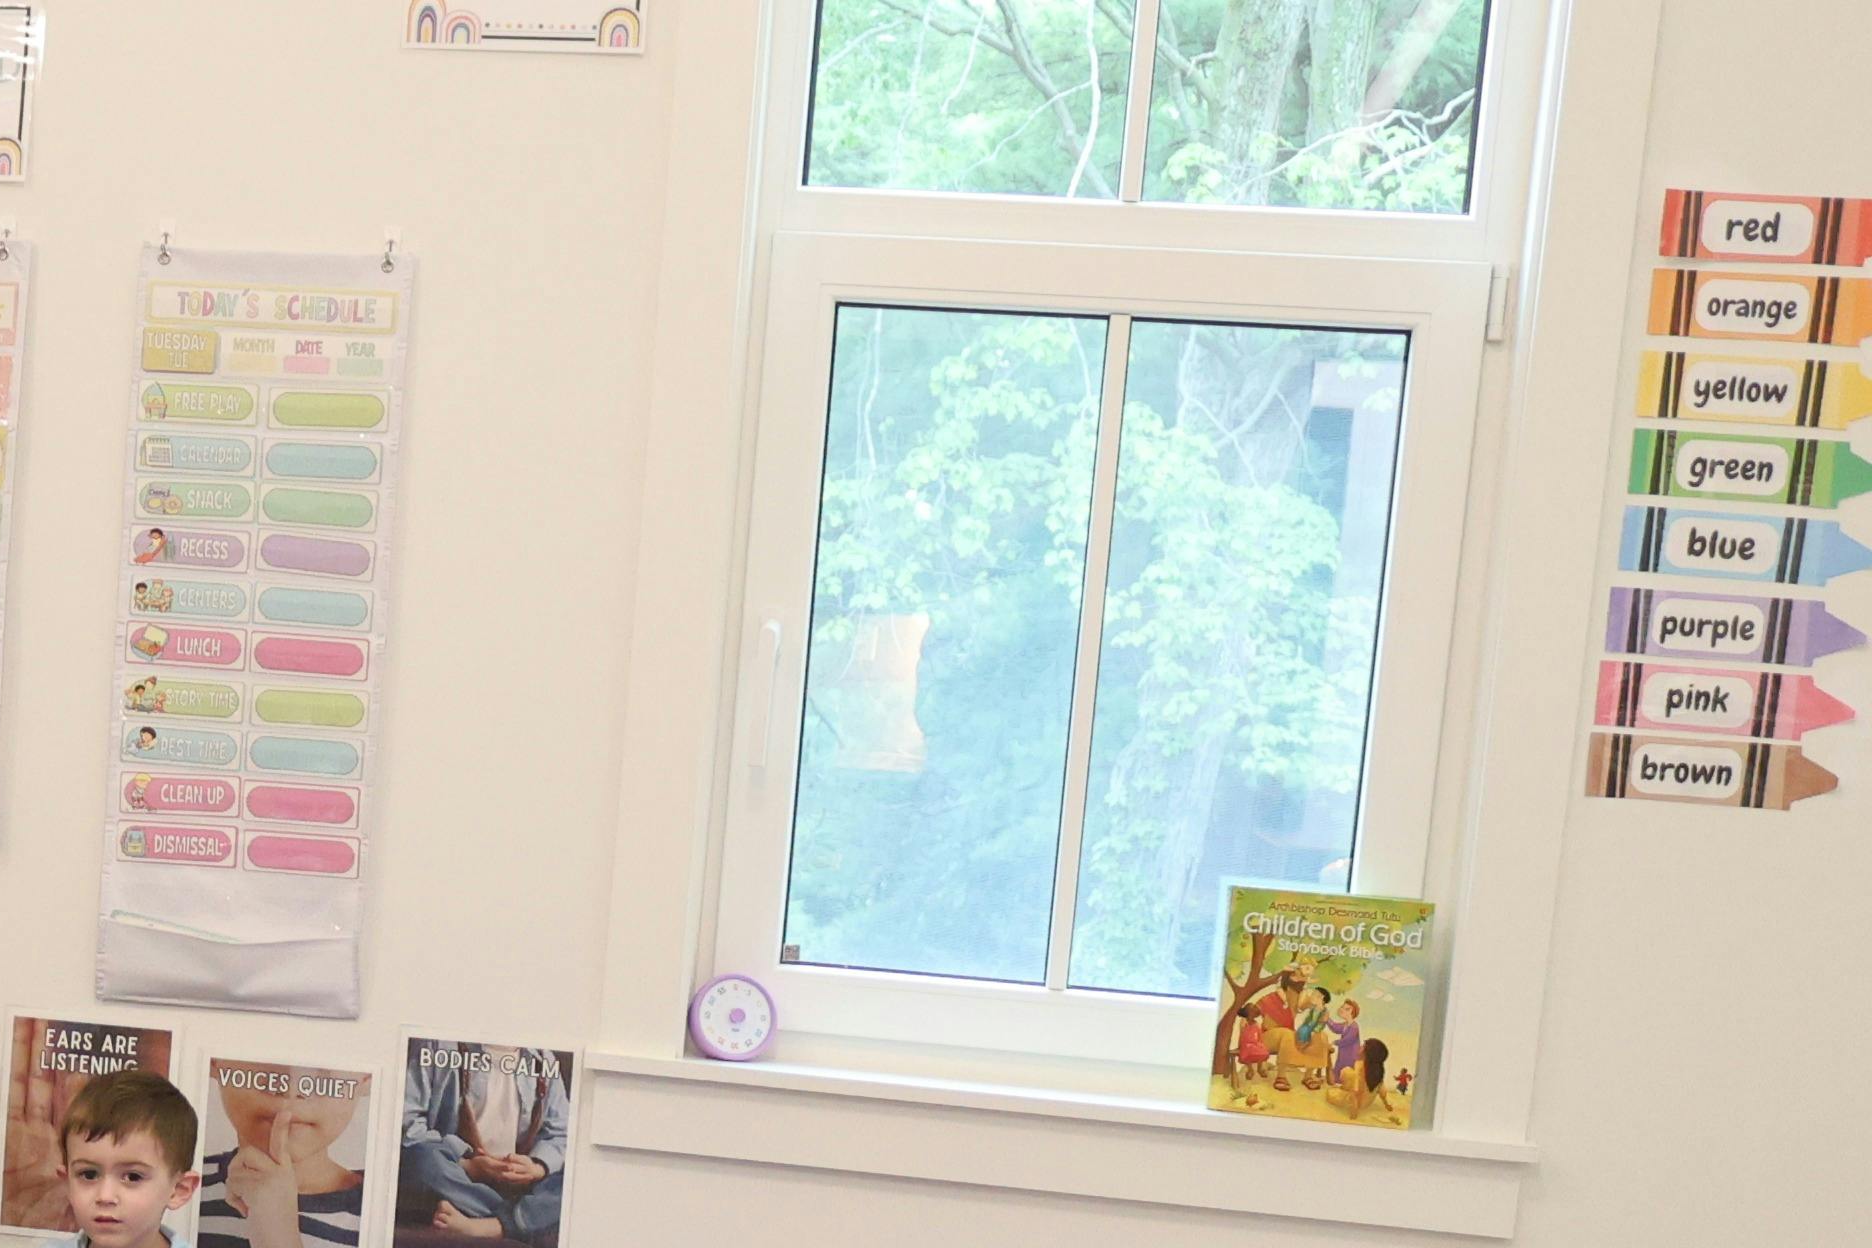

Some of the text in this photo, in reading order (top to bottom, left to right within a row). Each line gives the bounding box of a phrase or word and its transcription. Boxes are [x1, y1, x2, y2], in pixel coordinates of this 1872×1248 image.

[1726, 212, 1781, 243] red
[178, 289, 377, 324] TODAY'S SCHEDULE
[1707, 296, 1798, 328] orange
[146, 332, 208, 350] TUESDAY
[232, 338, 376, 358] MONTH DATE YEAR
[174, 392, 242, 414] FREE PLAY
[1693, 376, 1788, 408] yellow
[180, 444, 241, 464] CALENDAR
[1689, 456, 1774, 488] green
[187, 490, 232, 510] SNACK
[180, 537, 229, 560] RECESS
[1687, 527, 1755, 560] blue
[179, 588, 238, 610] CENTERS
[1660, 615, 1755, 648] purple
[177, 636, 221, 657] LUNCH
[166, 688, 236, 709] STORY TIME
[1664, 684, 1730, 718] pink
[160, 738, 227, 760] REST TIME
[1641, 753, 1732, 786] brown
[160, 784, 225, 805] CLEAN UP
[154, 834, 222, 856] DISMISSAL
[1269, 902, 1325, 915] Archbishop
[1329, 907, 1378, 920] Desmond
[1381, 911, 1401, 921] Tutu
[1243, 911, 1423, 948] Children of God
[1278, 938, 1383, 960] Storybook Bible
[45, 1028, 138, 1055] EARS ARE
[420, 1048, 560, 1079] BODIES CALM
[218, 1068, 358, 1099] VOICES QUIET
